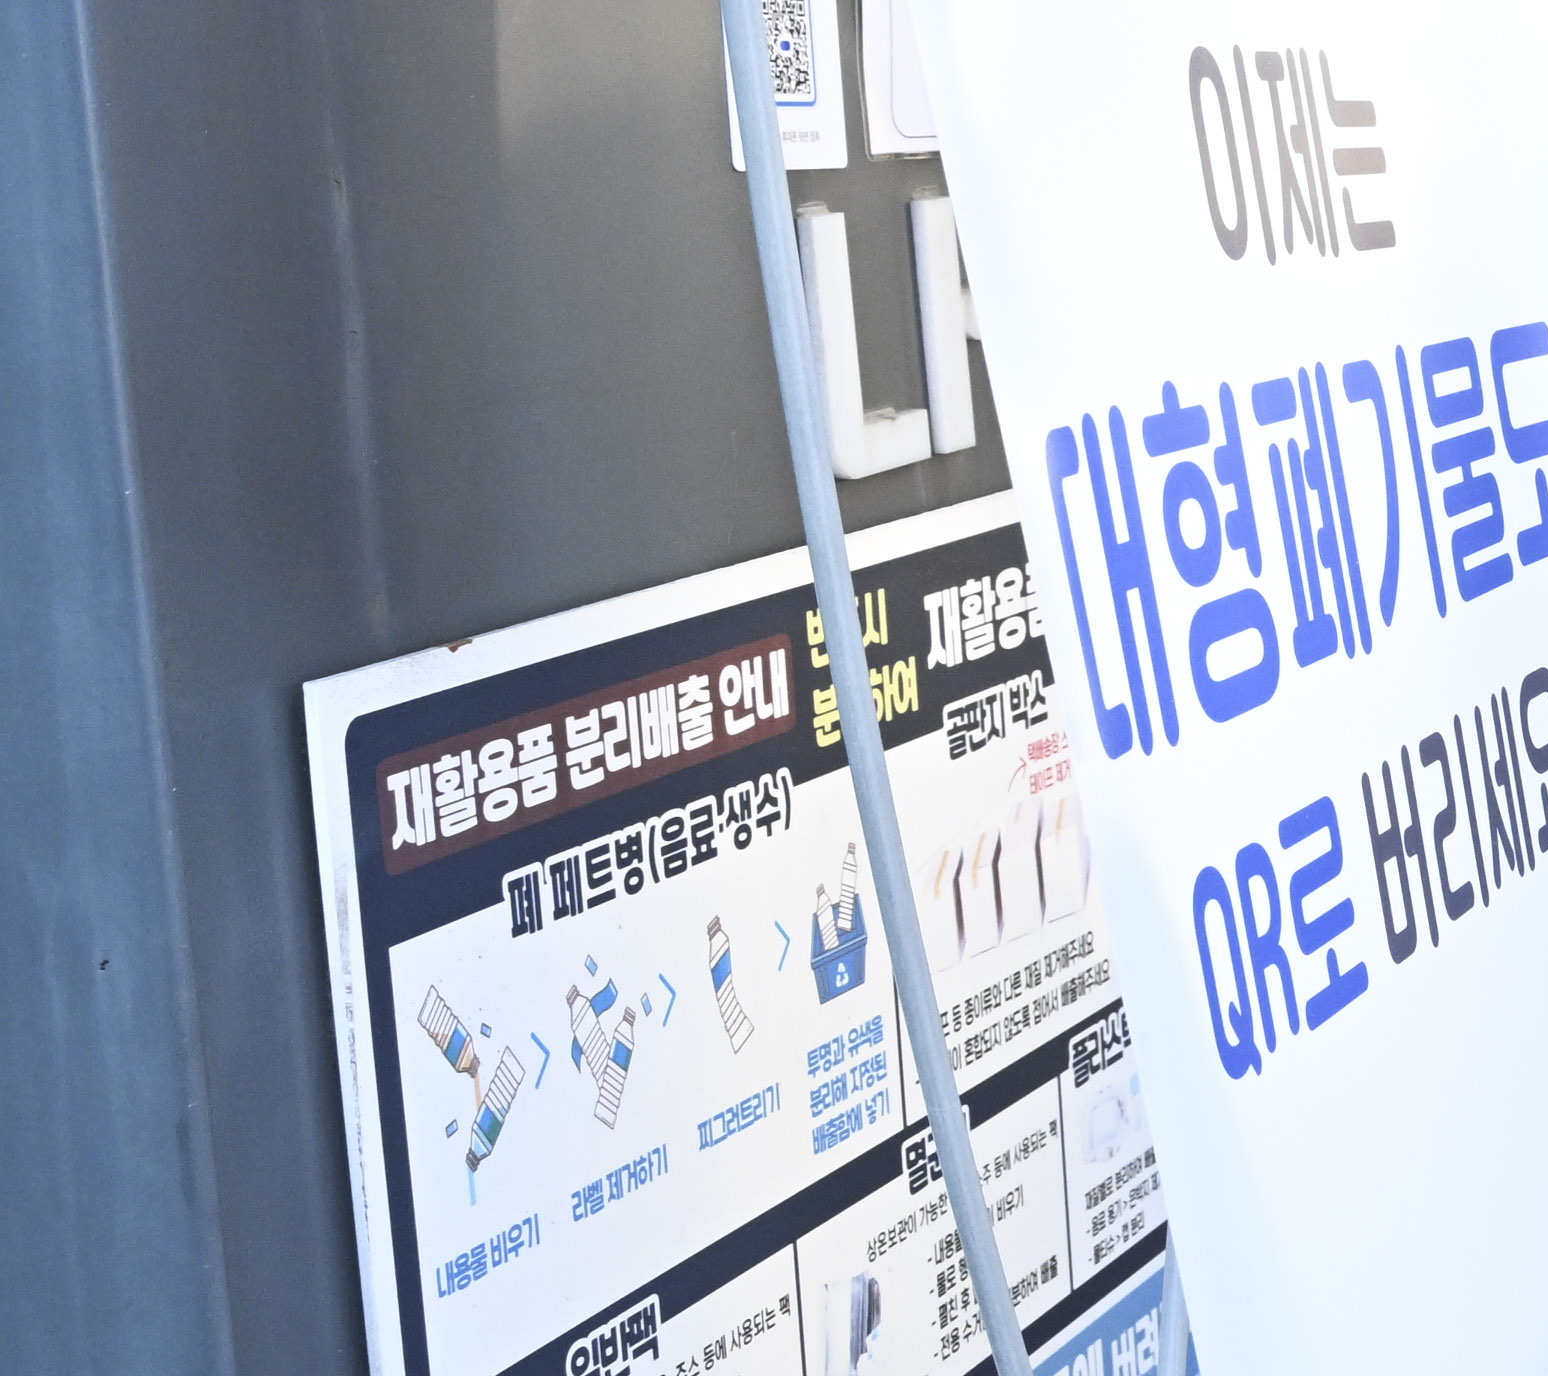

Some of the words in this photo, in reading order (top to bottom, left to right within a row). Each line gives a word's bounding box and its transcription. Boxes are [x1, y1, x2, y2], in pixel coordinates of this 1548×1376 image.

[1188, 42, 1397, 267] 이제는
[387, 724, 557, 847] 재활용품
[565, 674, 713, 789] 분리배출
[718, 648, 789, 735] 안내
[946, 691, 1006, 760] 골판지
[1008, 670, 1048, 729] 박스
[507, 870, 543, 938] 폐
[1191, 793, 1371, 1083] QR로
[963, 983, 1002, 1026] 종이류와
[1002, 970, 1022, 1002] 다른
[1023, 960, 1042, 989] 재질
[806, 1034, 845, 1078] 투명과
[847, 1014, 884, 1057] 유색을
[963, 1022, 1000, 1066] 혼합되지
[1003, 1003, 1031, 1042] 않도록
[1031, 992, 1059, 1025] 접어서
[696, 1082, 781, 1150] 찌그러트리기
[809, 1072, 848, 1118] 분리해
[849, 1050, 887, 1094] 지정된
[811, 1103, 863, 1155] 배출함에
[864, 1087, 890, 1125] 넣기
[570, 1178, 605, 1222] 라벨
[605, 1143, 668, 1203] 제거하기
[866, 1211, 917, 1263] 상온보관이
[918, 1191, 948, 1226] 가능한
[993, 1149, 1011, 1179] 등에
[1013, 1129, 1047, 1162] 사용되는
[995, 1184, 1024, 1222] 비우기
[435, 1242, 488, 1298] 내용물
[489, 1212, 541, 1268] 비우기
[935, 1263, 957, 1298] 물로
[702, 1334, 727, 1371] 등에
[729, 1307, 776, 1351] 사용되는
[778, 1293, 791, 1317] 팩
[937, 1295, 958, 1329] 펼친
[959, 1286, 971, 1311] 후
[939, 1326, 960, 1361] 전용
